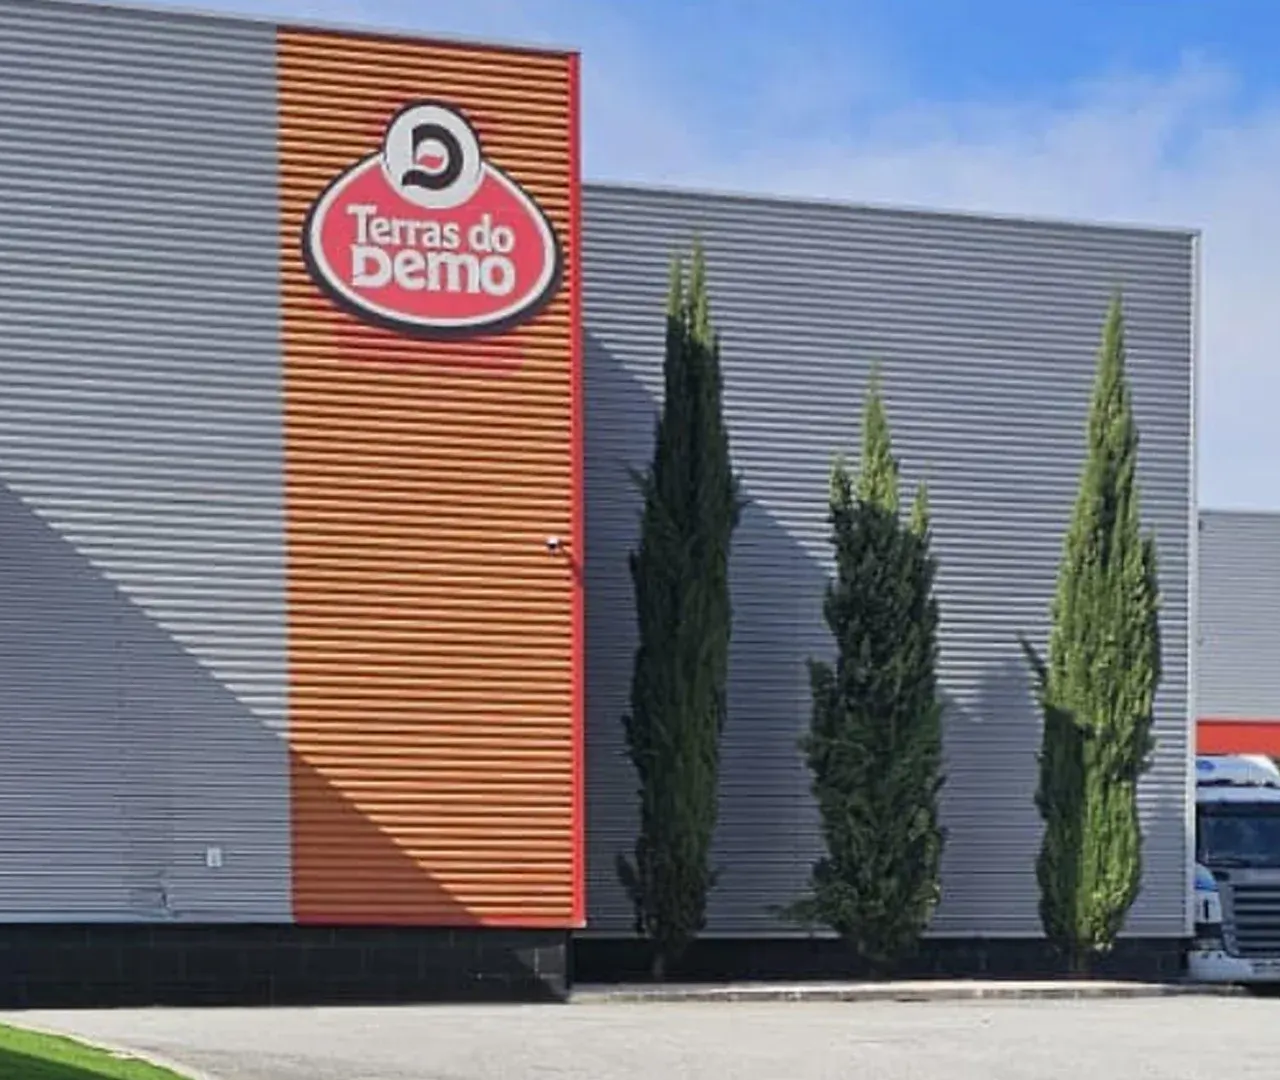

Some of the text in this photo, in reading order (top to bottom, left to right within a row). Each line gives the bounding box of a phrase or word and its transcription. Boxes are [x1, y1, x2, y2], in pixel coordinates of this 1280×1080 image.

[346, 203, 515, 253] Terras do
[349, 244, 516, 296] Demo
